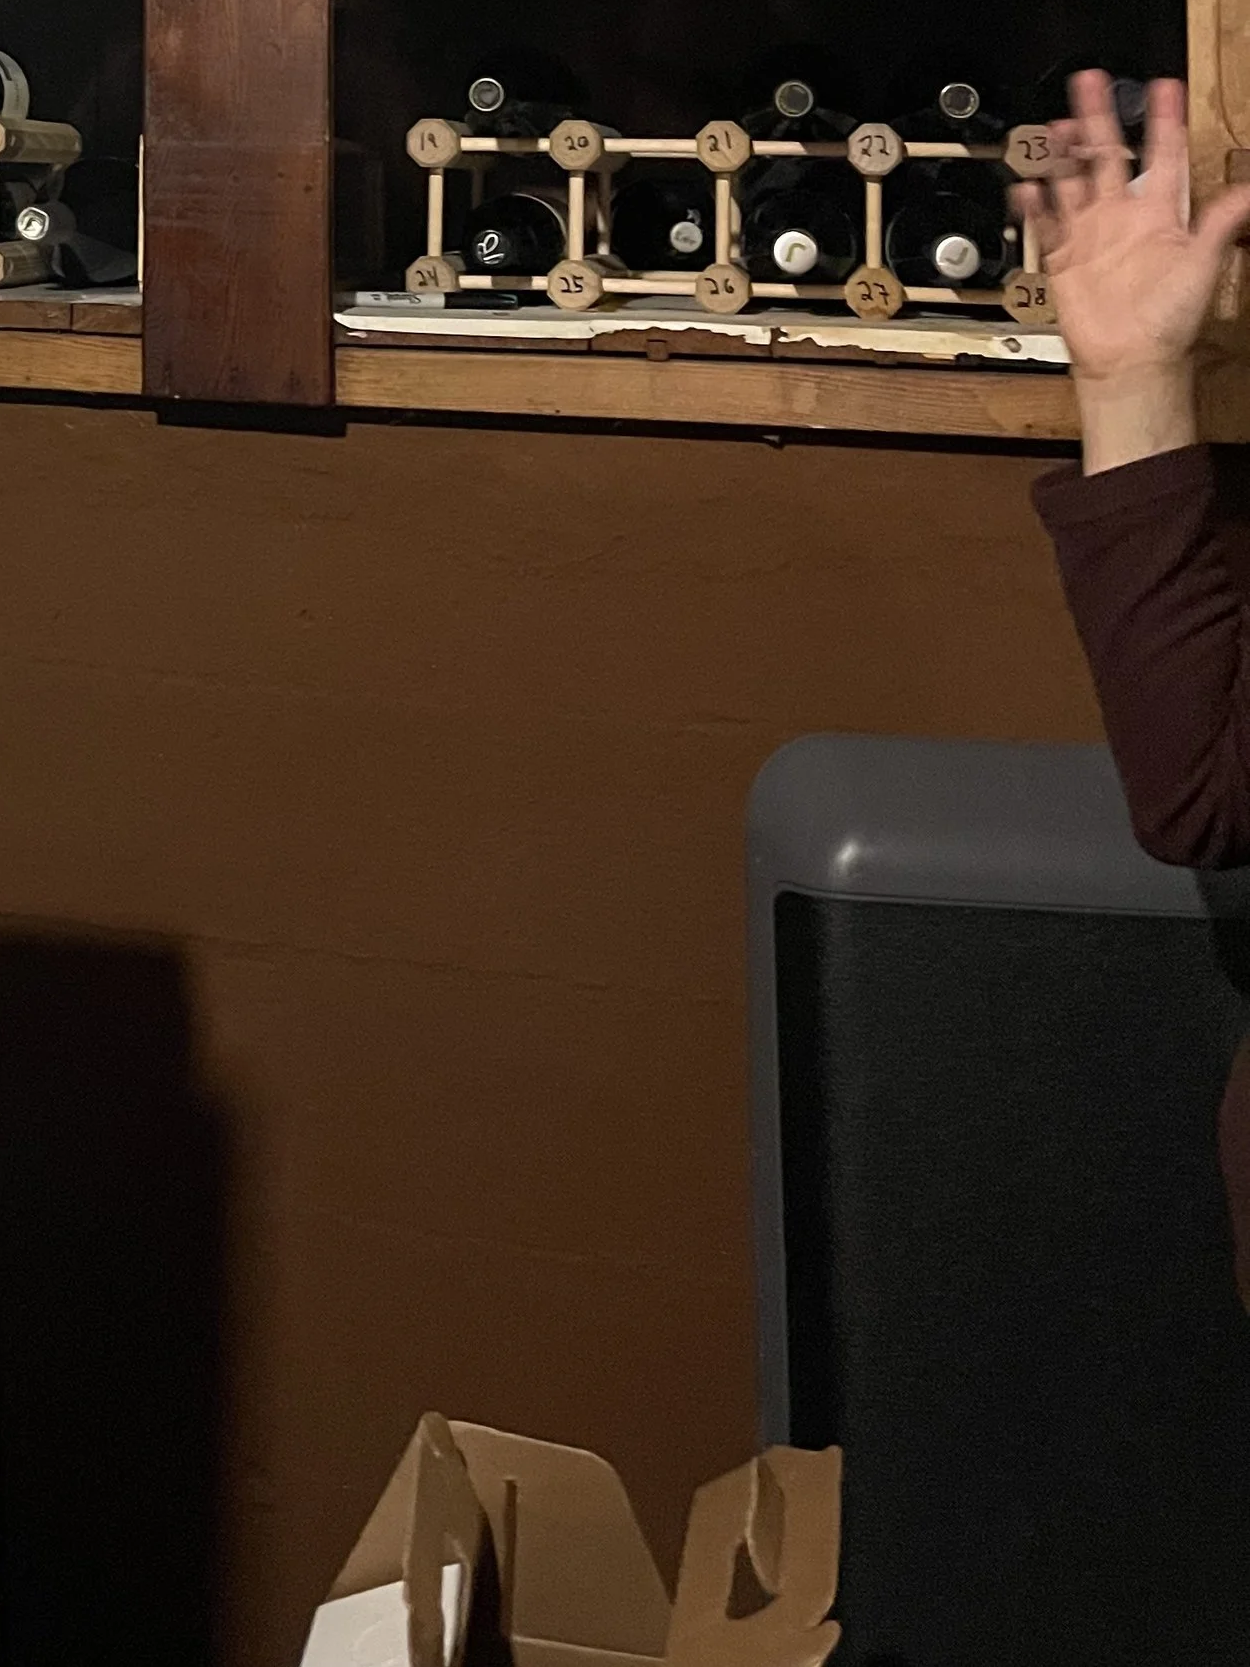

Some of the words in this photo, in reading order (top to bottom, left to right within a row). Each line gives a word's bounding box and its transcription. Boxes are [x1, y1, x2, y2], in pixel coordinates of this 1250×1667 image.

[420, 132, 436, 151] 19
[564, 135, 590, 151] 20
[707, 131, 731, 153] 21
[858, 134, 889, 157] 22
[1018, 136, 1050, 161] 23
[415, 266, 440, 287] 24
[560, 276, 584, 293] 25
[705, 277, 734, 294] 26
[860, 282, 890, 306] 27
[1015, 286, 1046, 308] 28
